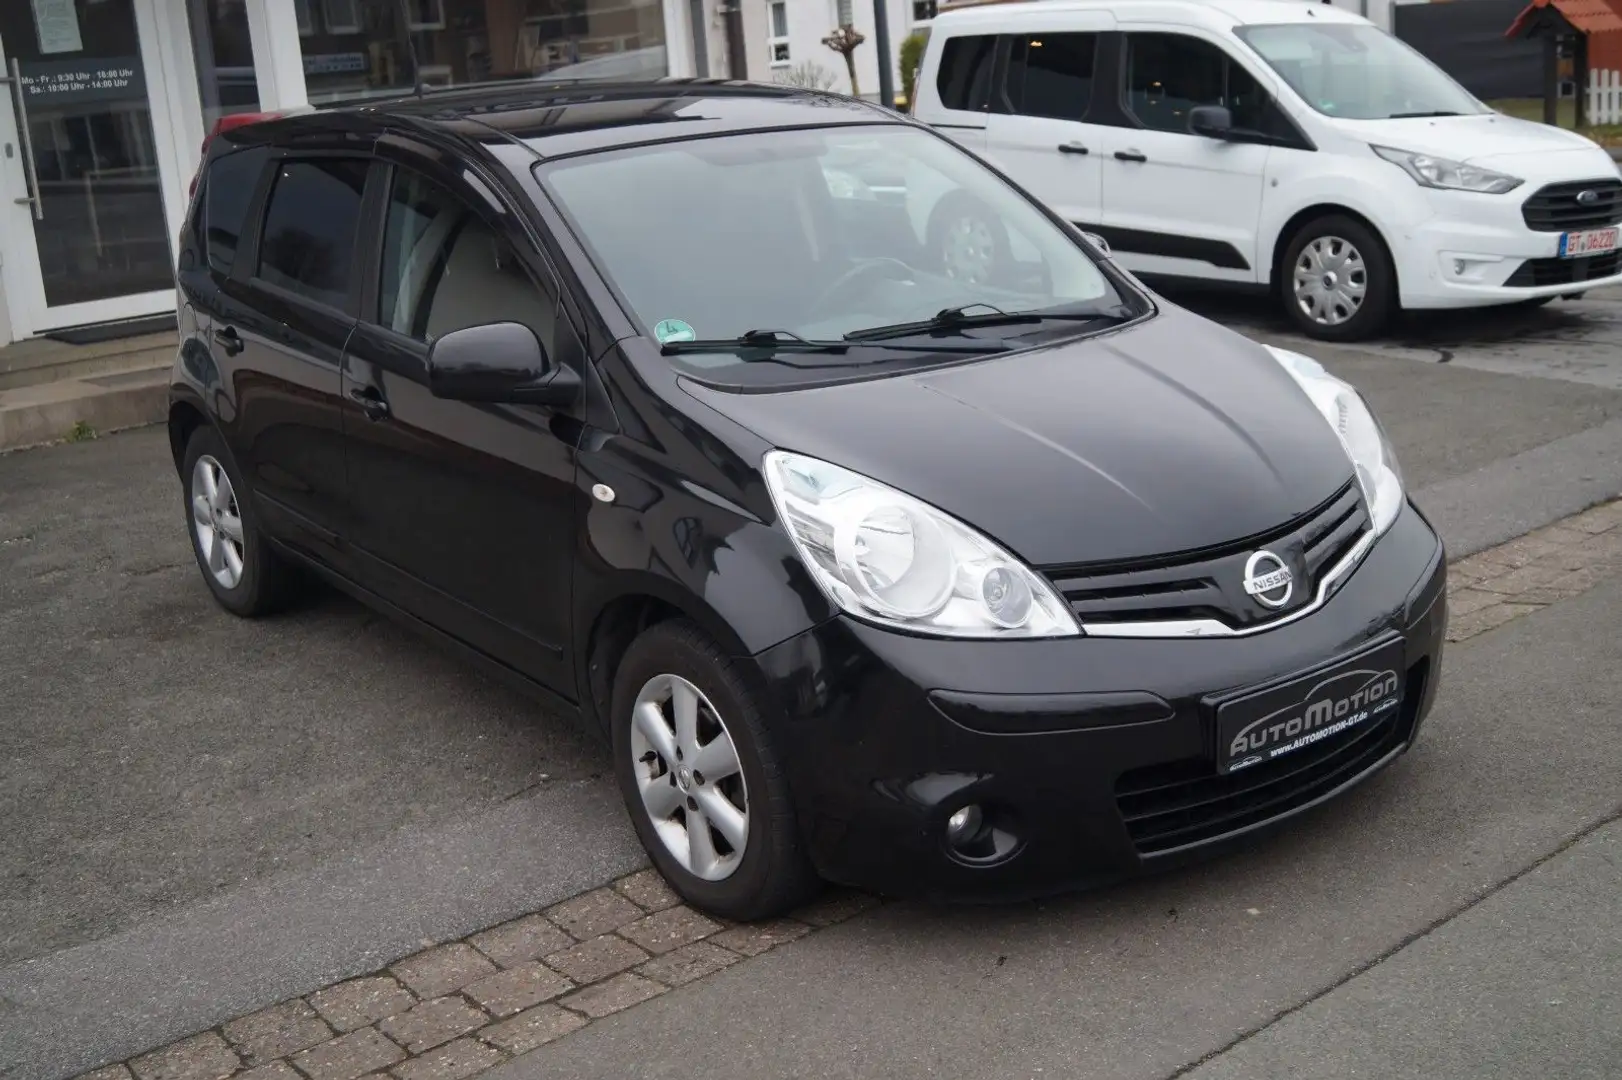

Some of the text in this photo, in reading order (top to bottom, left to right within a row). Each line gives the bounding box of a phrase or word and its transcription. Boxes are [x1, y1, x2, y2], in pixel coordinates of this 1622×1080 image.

[21, 77, 34, 85] Mo
[41, 75, 49, 84] Fr
[76, 72, 90, 81] Uhr
[119, 69, 133, 77] Uhr
[70, 82, 85, 91] Uhr
[114, 79, 128, 87] Uhr
[1568, 234, 1581, 251] GT
[1253, 570, 1292, 590] NISSAN
[1270, 711, 1368, 757] www.AUTOMOTION-GT.de
